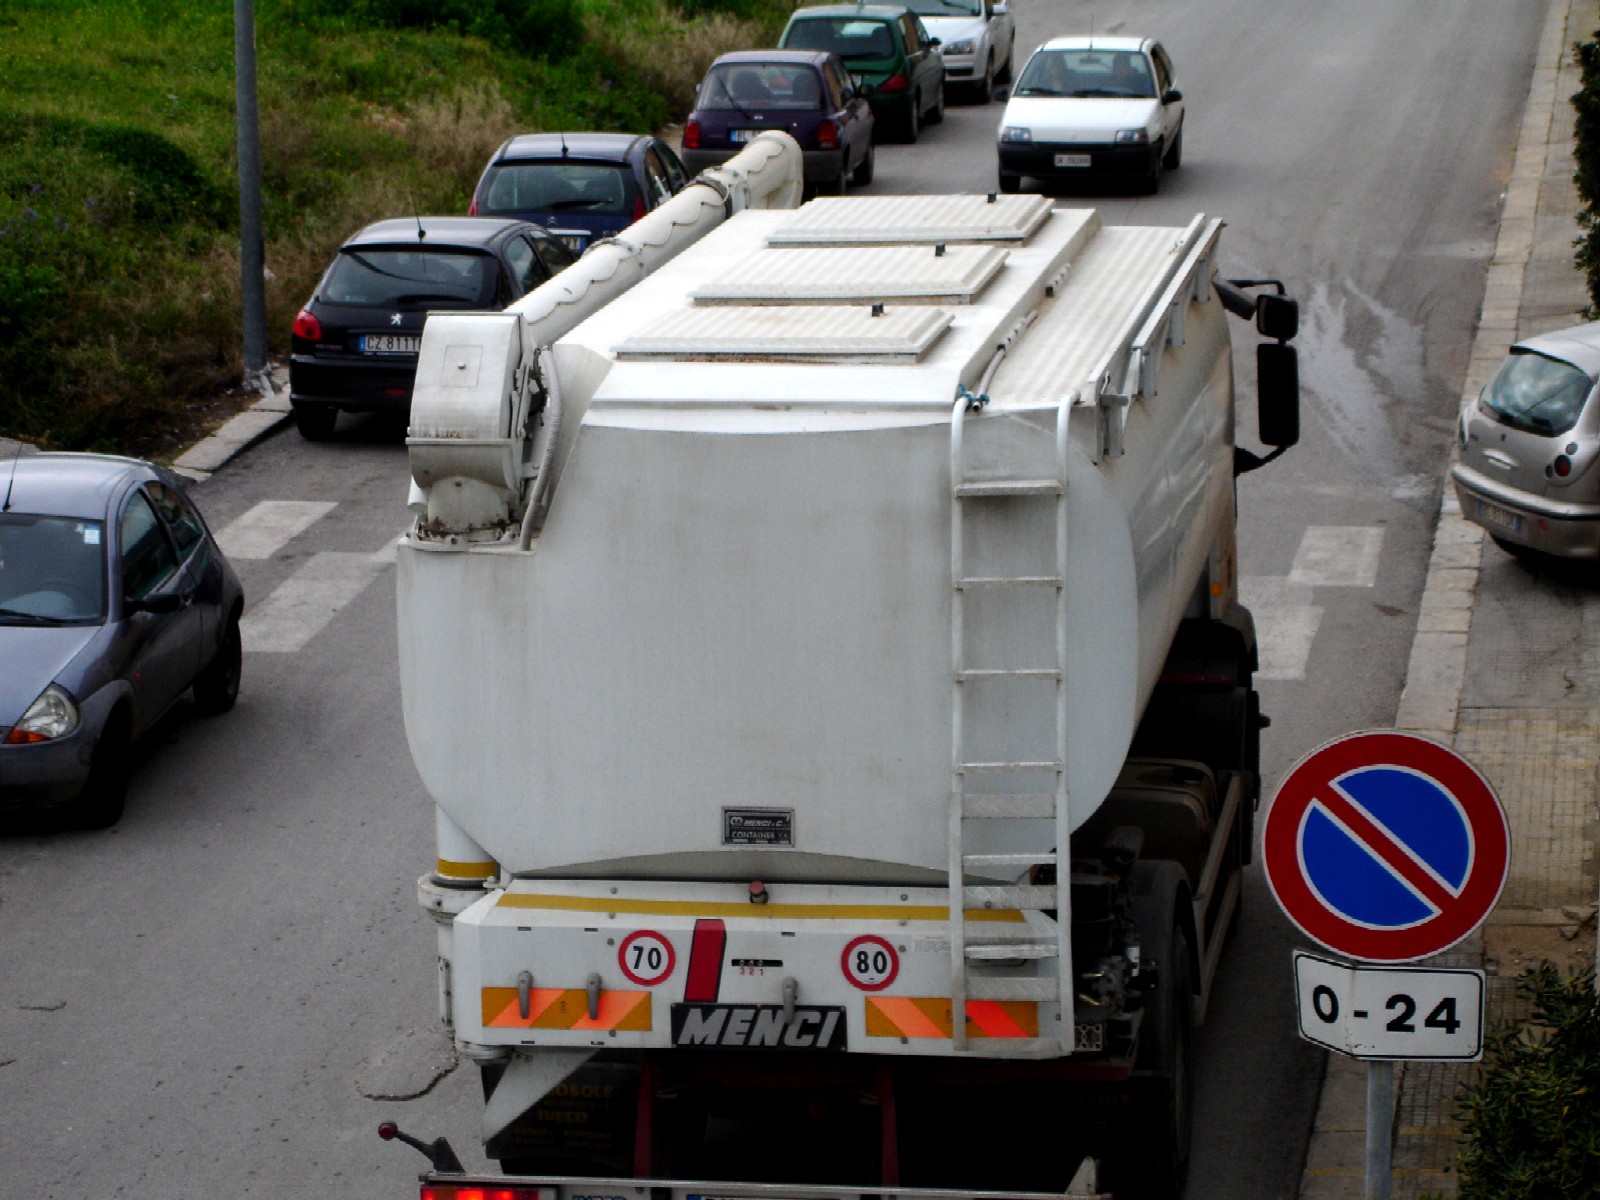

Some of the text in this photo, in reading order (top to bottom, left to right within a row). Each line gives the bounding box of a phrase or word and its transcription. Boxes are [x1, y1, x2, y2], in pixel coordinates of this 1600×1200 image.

[367, 336, 422, 351] CZ 811T
[731, 831, 775, 839] CONTAINER
[632, 945, 662, 970] 70
[856, 950, 887, 974] 80
[1312, 984, 1340, 1024] 0
[1384, 993, 1461, 1035] 24
[677, 1007, 841, 1049] MENCI
[537, 1109, 589, 1123] IVECO
